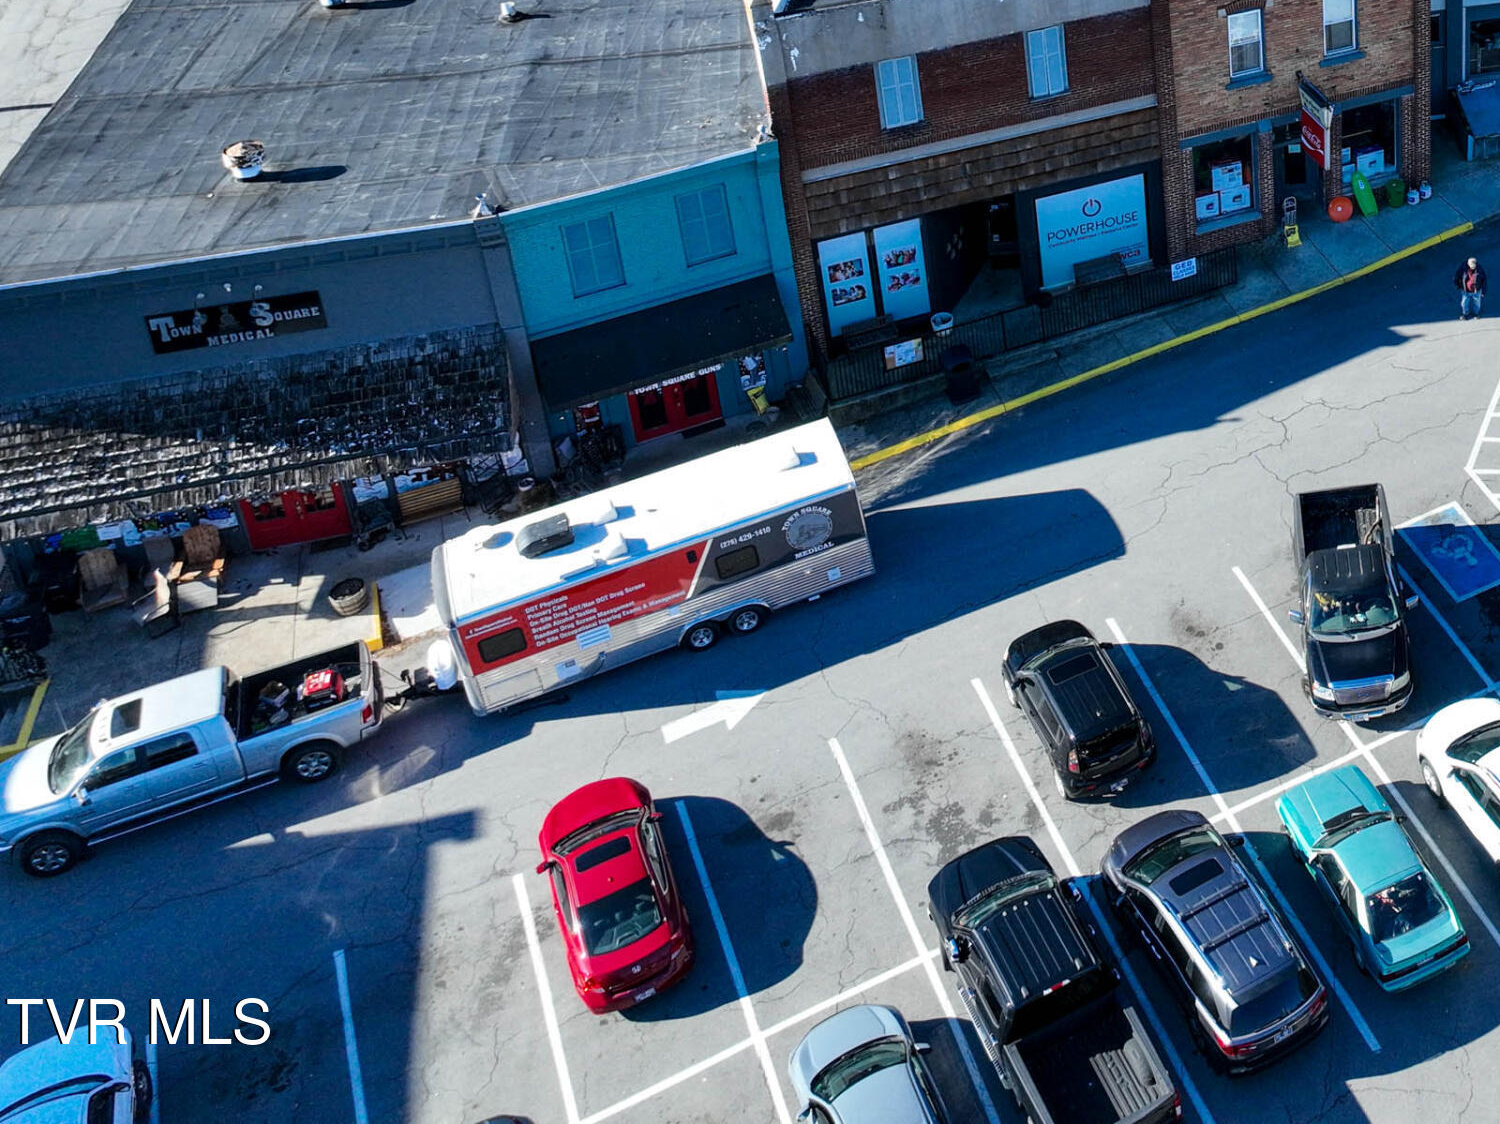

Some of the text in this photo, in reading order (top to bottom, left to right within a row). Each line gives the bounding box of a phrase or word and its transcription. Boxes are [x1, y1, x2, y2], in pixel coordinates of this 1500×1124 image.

[1047, 210, 1138, 242] POWERHOUSE
[149, 302, 320, 342] TOWN SQUARE
[207, 328, 275, 347] MEDICAL
[634, 363, 721, 395] TOWN SQUARE GUNS
[781, 506, 832, 531] TOWN SQUARE
[794, 542, 835, 560] MEDICAL
[525, 595, 568, 614] DOT Physicals
[527, 603, 567, 620] Primary Care
[553, 610, 568, 619] Drug
[595, 594, 609, 604] DOT
[609, 590, 624, 599] Drug
[553, 614, 575, 626] Alcohol
[575, 607, 597, 618] Testing
[559, 623, 575, 632] Drug
[597, 600, 635, 617] Management
